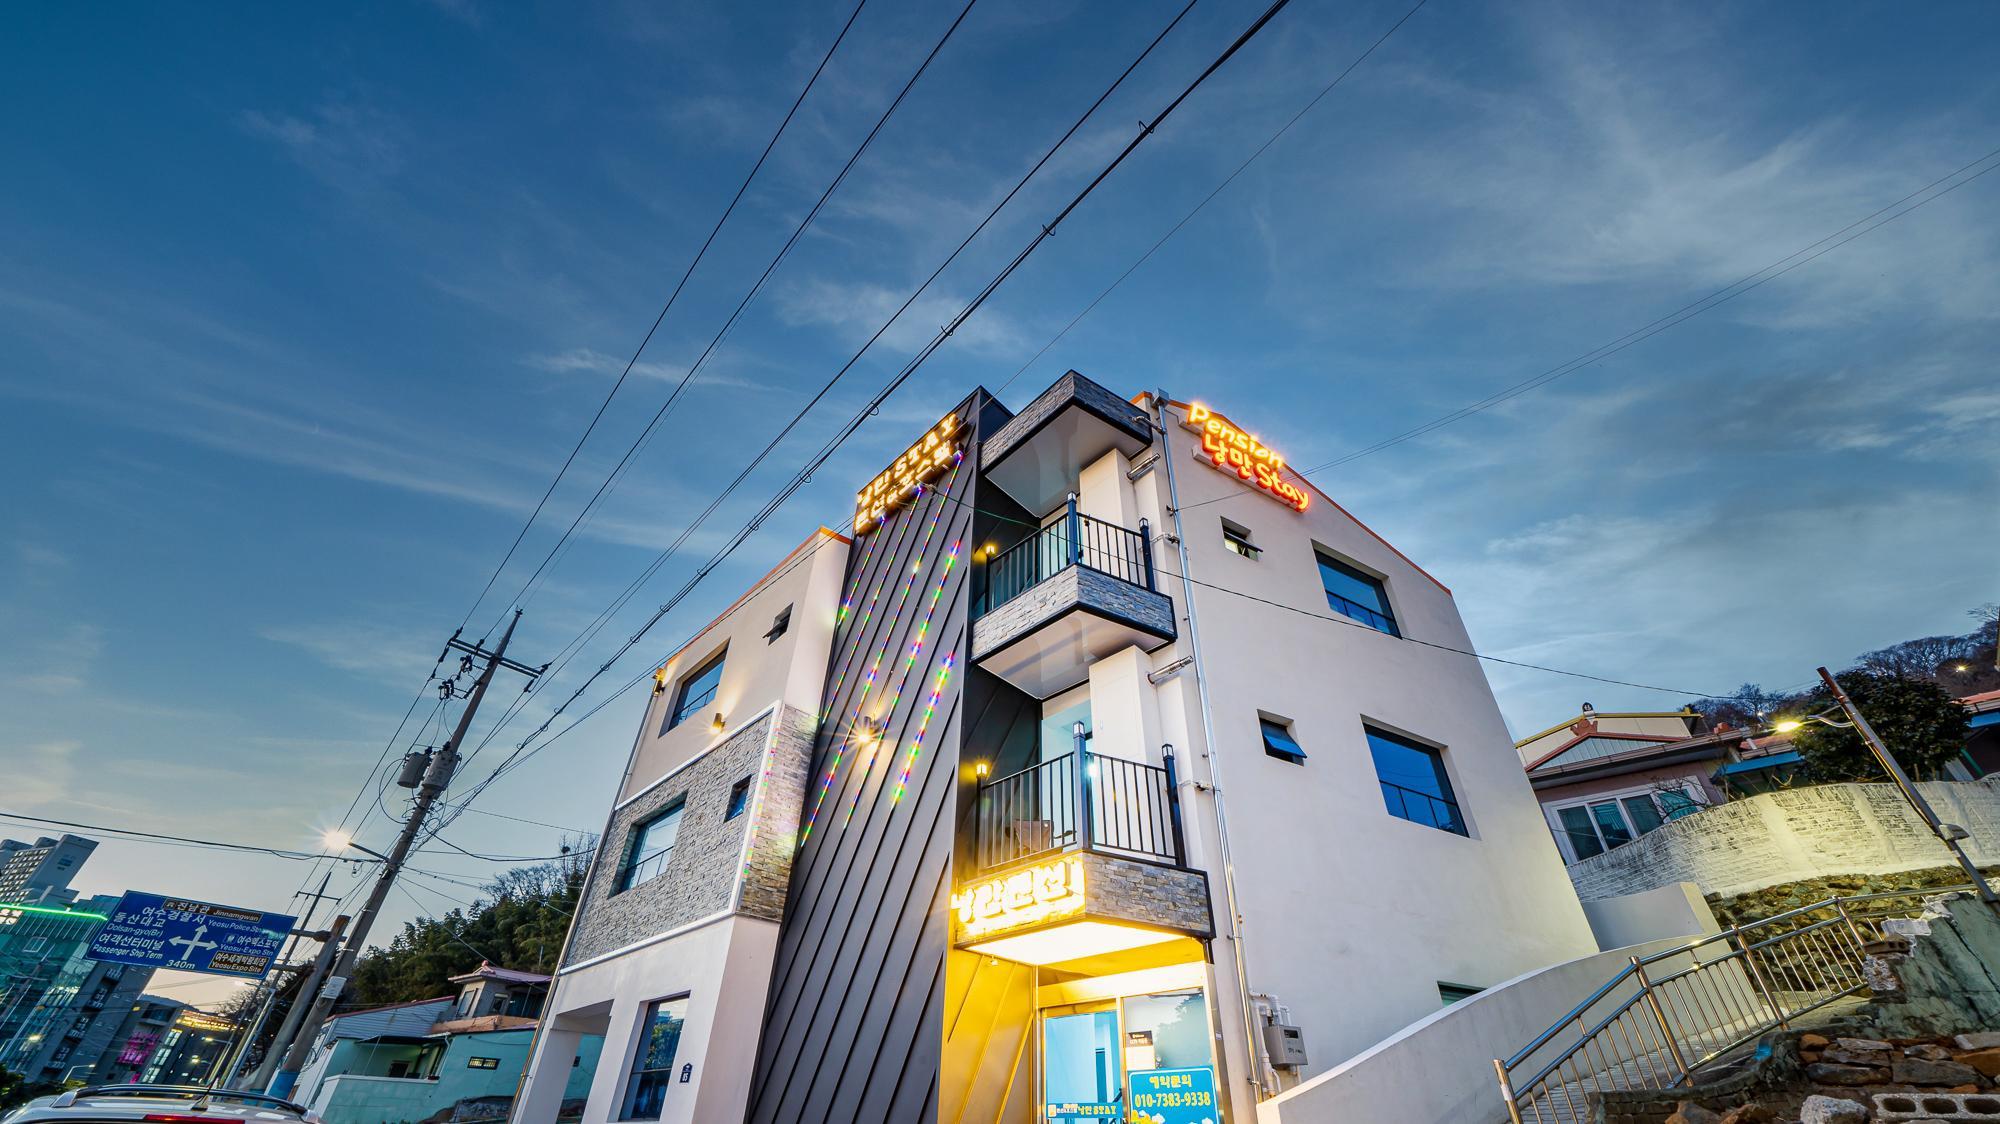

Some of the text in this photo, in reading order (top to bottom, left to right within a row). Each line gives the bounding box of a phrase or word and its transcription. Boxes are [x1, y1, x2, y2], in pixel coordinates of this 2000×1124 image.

[1189, 402, 1284, 469] Pension
[113, 912, 165, 927] 돌산대교
[142, 906, 206, 924] 여수경찰서
[208, 919, 230, 929] Yeosu
[229, 922, 251, 932] Police
[177, 902, 259, 921] 진남관 Jinnamgwan
[99, 933, 164, 950] 여객선터미널
[93, 943, 164, 959] Passenger Ship Term
[166, 959, 196, 969] 340m
[211, 961, 262, 973] Yeosu Expo Site
[1134, 1091, 1211, 1107] 010-7383-9338
